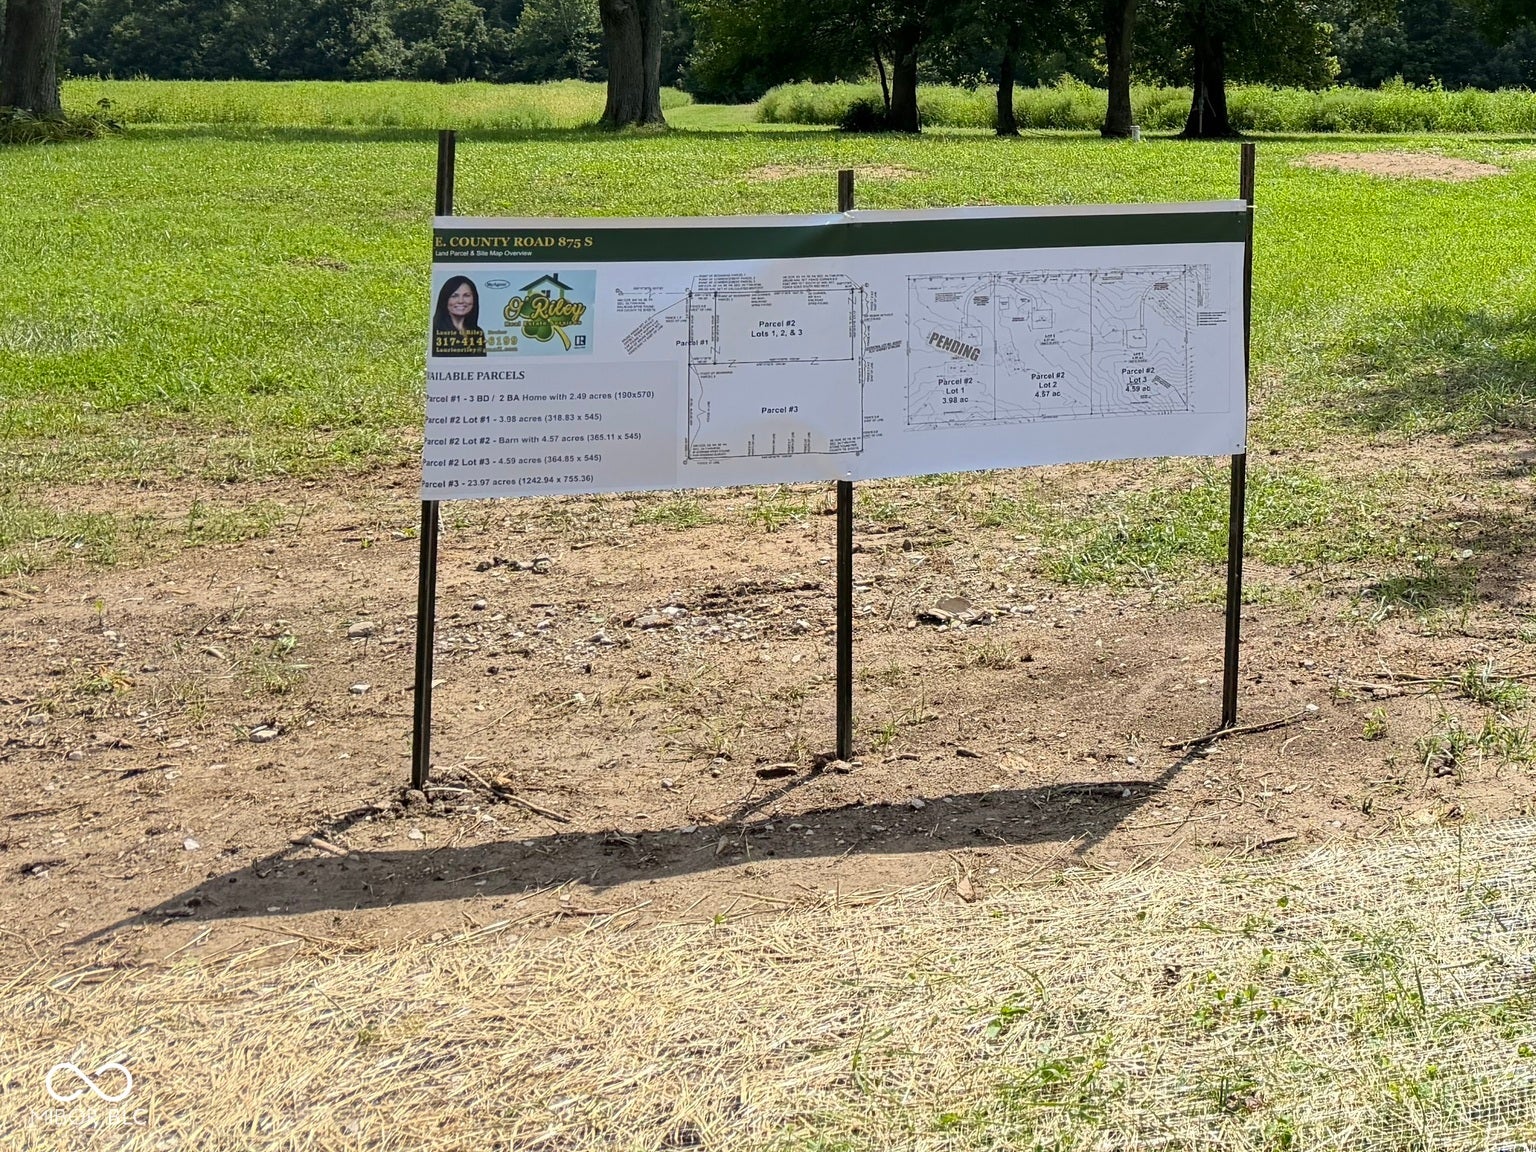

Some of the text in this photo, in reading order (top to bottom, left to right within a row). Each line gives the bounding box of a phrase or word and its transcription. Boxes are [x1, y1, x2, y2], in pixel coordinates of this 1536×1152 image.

[435, 236, 593, 248] E. COUNTY ROAD 875 S
[490, 250, 503, 258] Map
[504, 295, 587, 322] O'Riley
[772, 330, 778, 338] 1,
[929, 332, 981, 362] PENDING
[477, 370, 525, 381] PARCELS
[450, 395, 460, 403] #1
[522, 394, 547, 402] Home
[463, 416, 478, 424] Lot
[585, 414, 602, 422] 545)
[521, 436, 539, 444] with
[624, 433, 642, 441] 545)
[422, 459, 446, 467] Parcel
[462, 458, 476, 466] Lot
[422, 480, 446, 488] Parcel
[448, 480, 459, 488] #3
[518, 477, 554, 486] (1242.94
[564, 475, 594, 483] 755.36)
